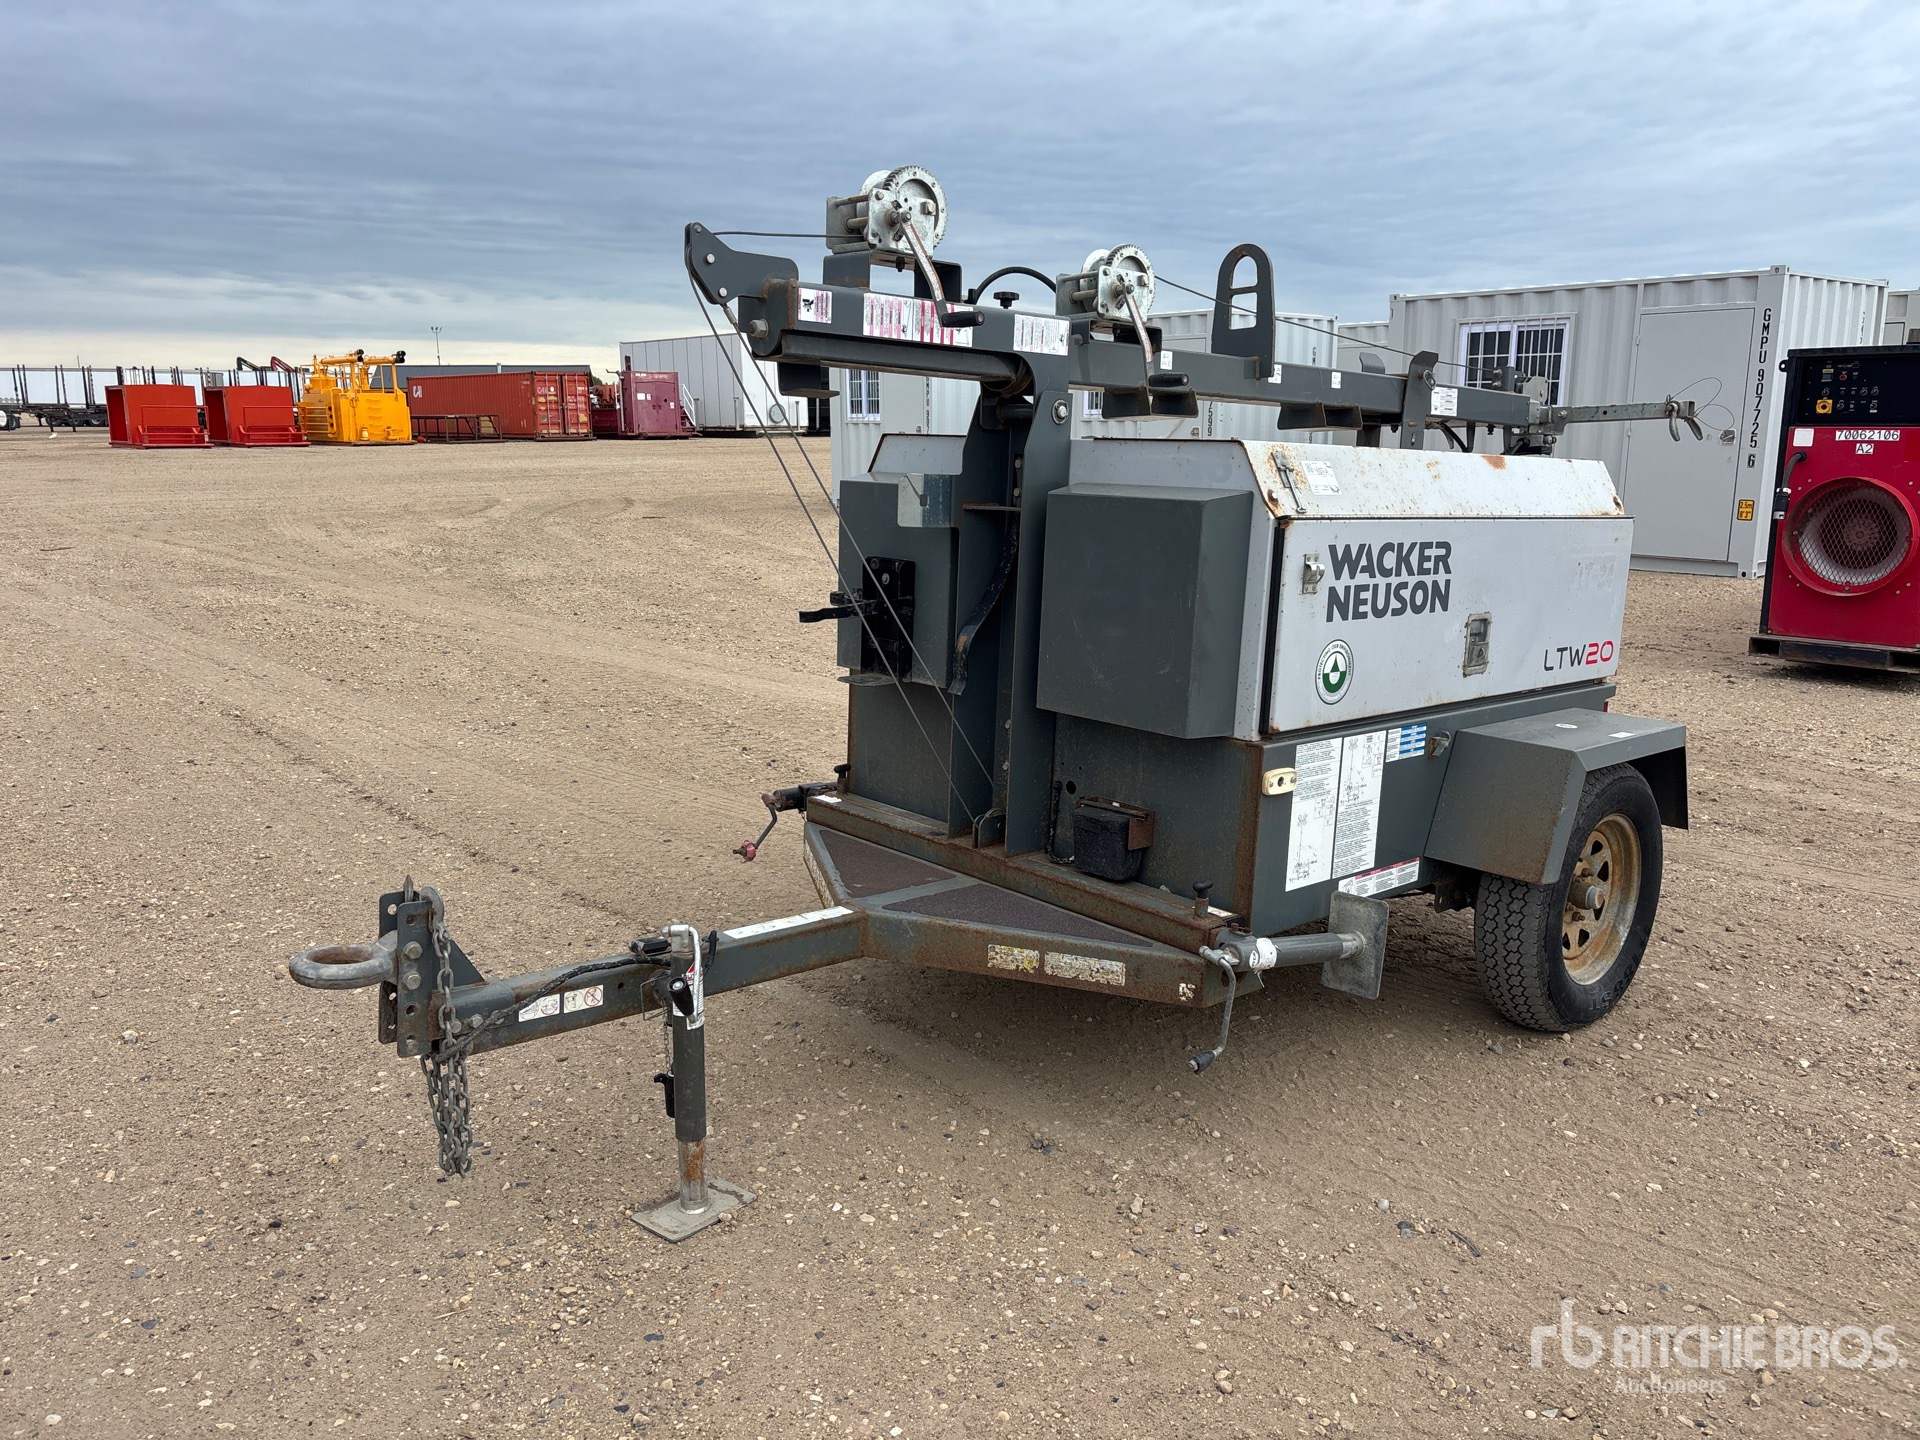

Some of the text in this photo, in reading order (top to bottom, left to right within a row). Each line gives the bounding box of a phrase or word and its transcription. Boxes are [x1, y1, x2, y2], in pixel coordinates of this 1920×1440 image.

[1758, 308, 1772, 363] GMPU
[1750, 369, 1765, 448] 907725
[1837, 430, 1899, 440] 70062106
[1856, 443, 1873, 454] A2
[1328, 541, 1452, 580] WACKER
[1326, 579, 1451, 622] NEUSON
[1543, 640, 1614, 672] LTW20
